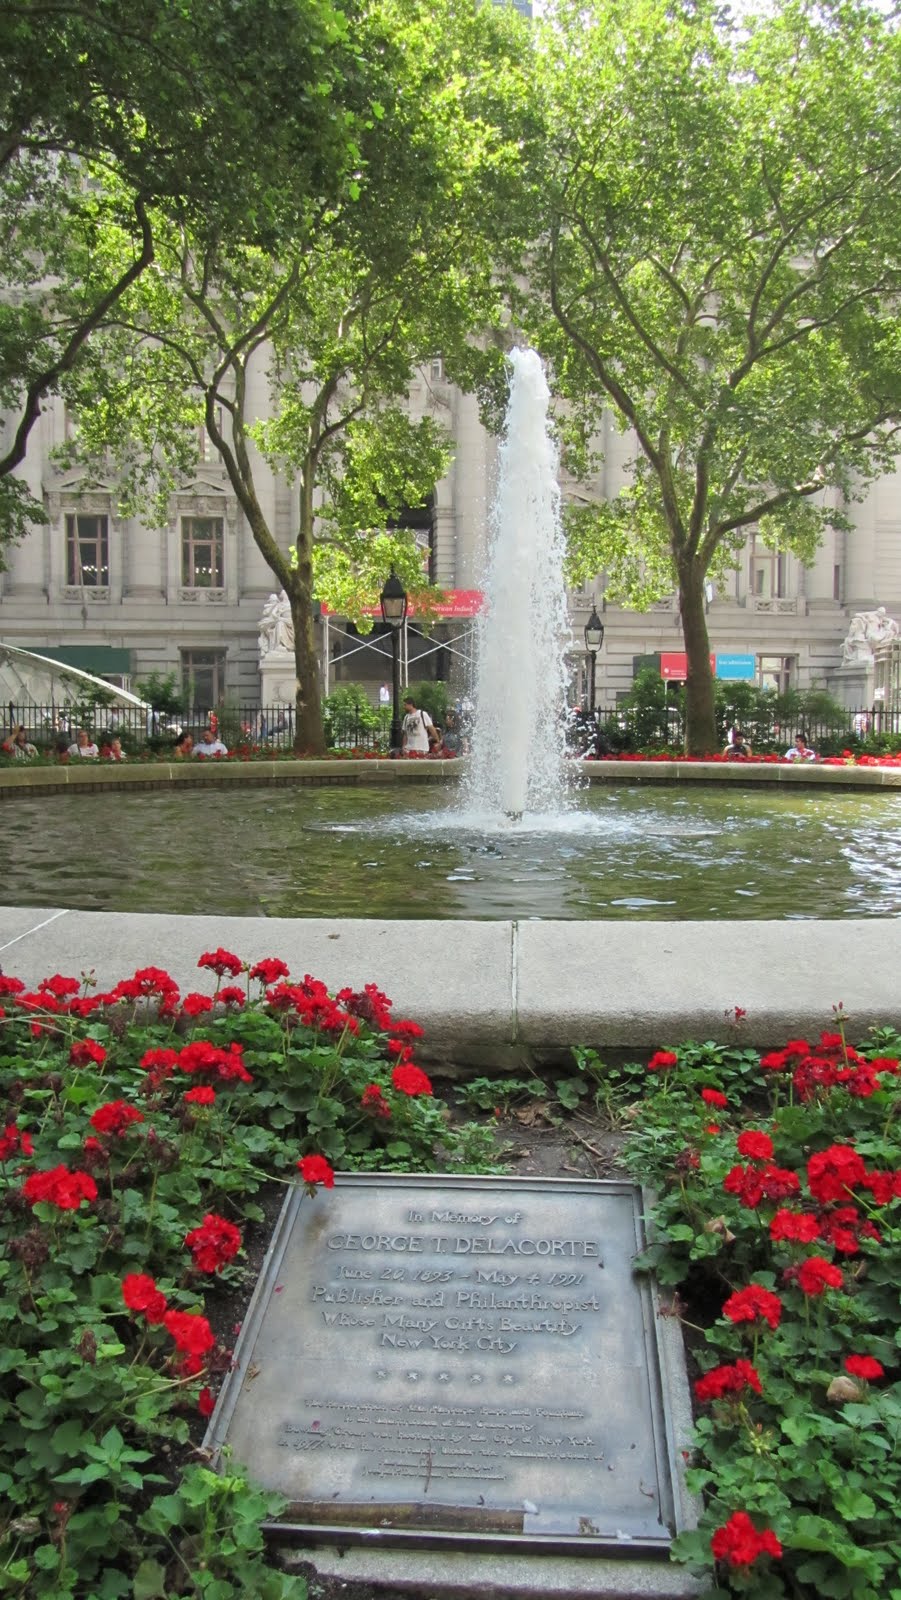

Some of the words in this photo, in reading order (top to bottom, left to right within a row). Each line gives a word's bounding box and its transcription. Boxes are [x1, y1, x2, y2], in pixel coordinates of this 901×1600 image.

[408, 1210, 423, 1222] In
[431, 1211, 498, 1226] Memory
[504, 1212, 523, 1224] of
[327, 1235, 424, 1253] GEORGE
[431, 1237, 447, 1253] T.
[453, 1237, 599, 1258] DELACORTE
[337, 1265, 373, 1280] June
[413, 1269, 454, 1284] 1893
[476, 1270, 520, 1287] May
[547, 1273, 585, 1287] 1991
[311, 1286, 404, 1306] Publisher
[411, 1290, 445, 1308] and
[455, 1291, 600, 1315] Philanthropist
[322, 1311, 376, 1328] Whose
[382, 1314, 439, 1332] Many
[444, 1316, 494, 1332] Gifts
[499, 1317, 583, 1336] Beautify
[380, 1333, 424, 1349] New
[430, 1335, 470, 1351] York
[476, 1336, 519, 1354] City
